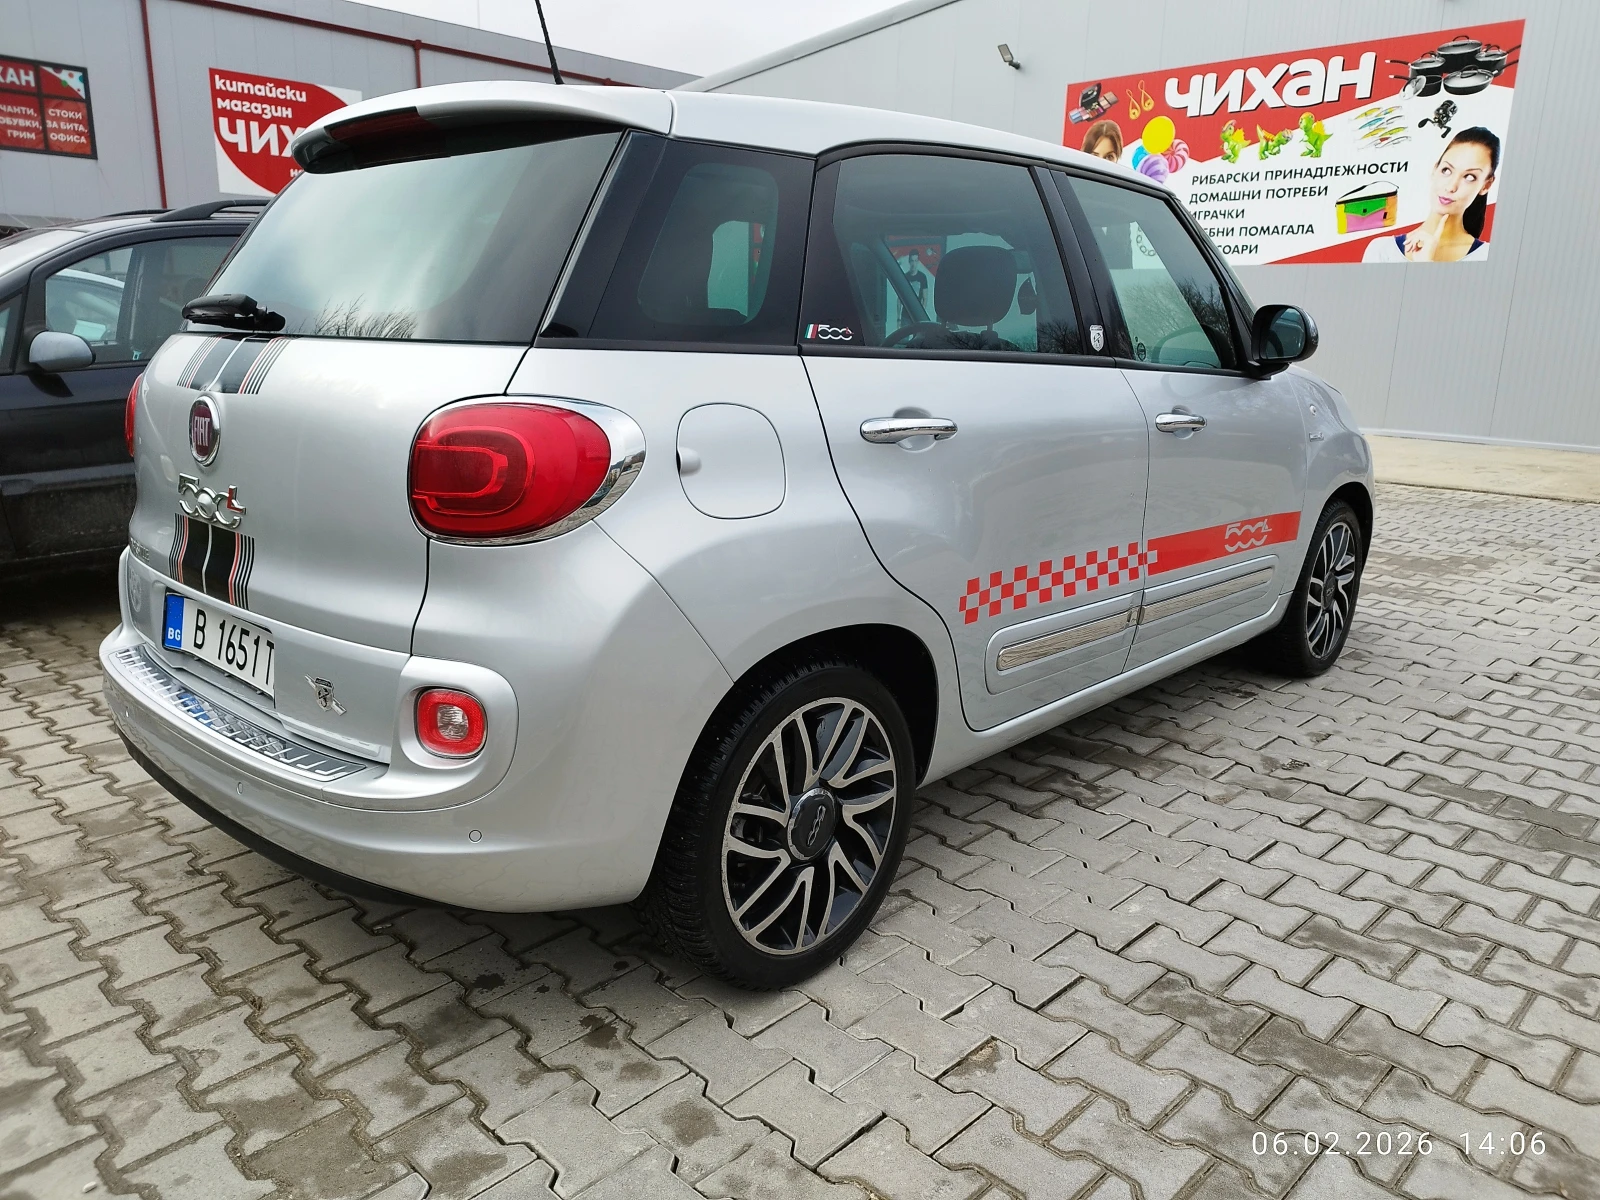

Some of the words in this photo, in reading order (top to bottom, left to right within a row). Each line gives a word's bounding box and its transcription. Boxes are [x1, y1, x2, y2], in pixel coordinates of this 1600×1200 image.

[214, 74, 307, 103] китайски
[48, 108, 82, 120] СТОКИ
[216, 97, 293, 119] магазин
[46, 119, 59, 130] ЗА
[60, 121, 88, 133] БИТА,
[7, 129, 36, 140] ГРИМ
[49, 132, 87, 144] ОФИСА
[1191, 172, 1260, 187] РИБАРСКИ
[1264, 161, 1409, 182] ПРИНАДЛЕЖНОСТИ
[1189, 190, 1261, 205] ДОМАШНИ
[1265, 185, 1328, 201] ПОТРЕБИ
[1238, 224, 1315, 237] ПОМАГАЛА
[193, 416, 211, 448] FIAT
[167, 626, 182, 642] BG
